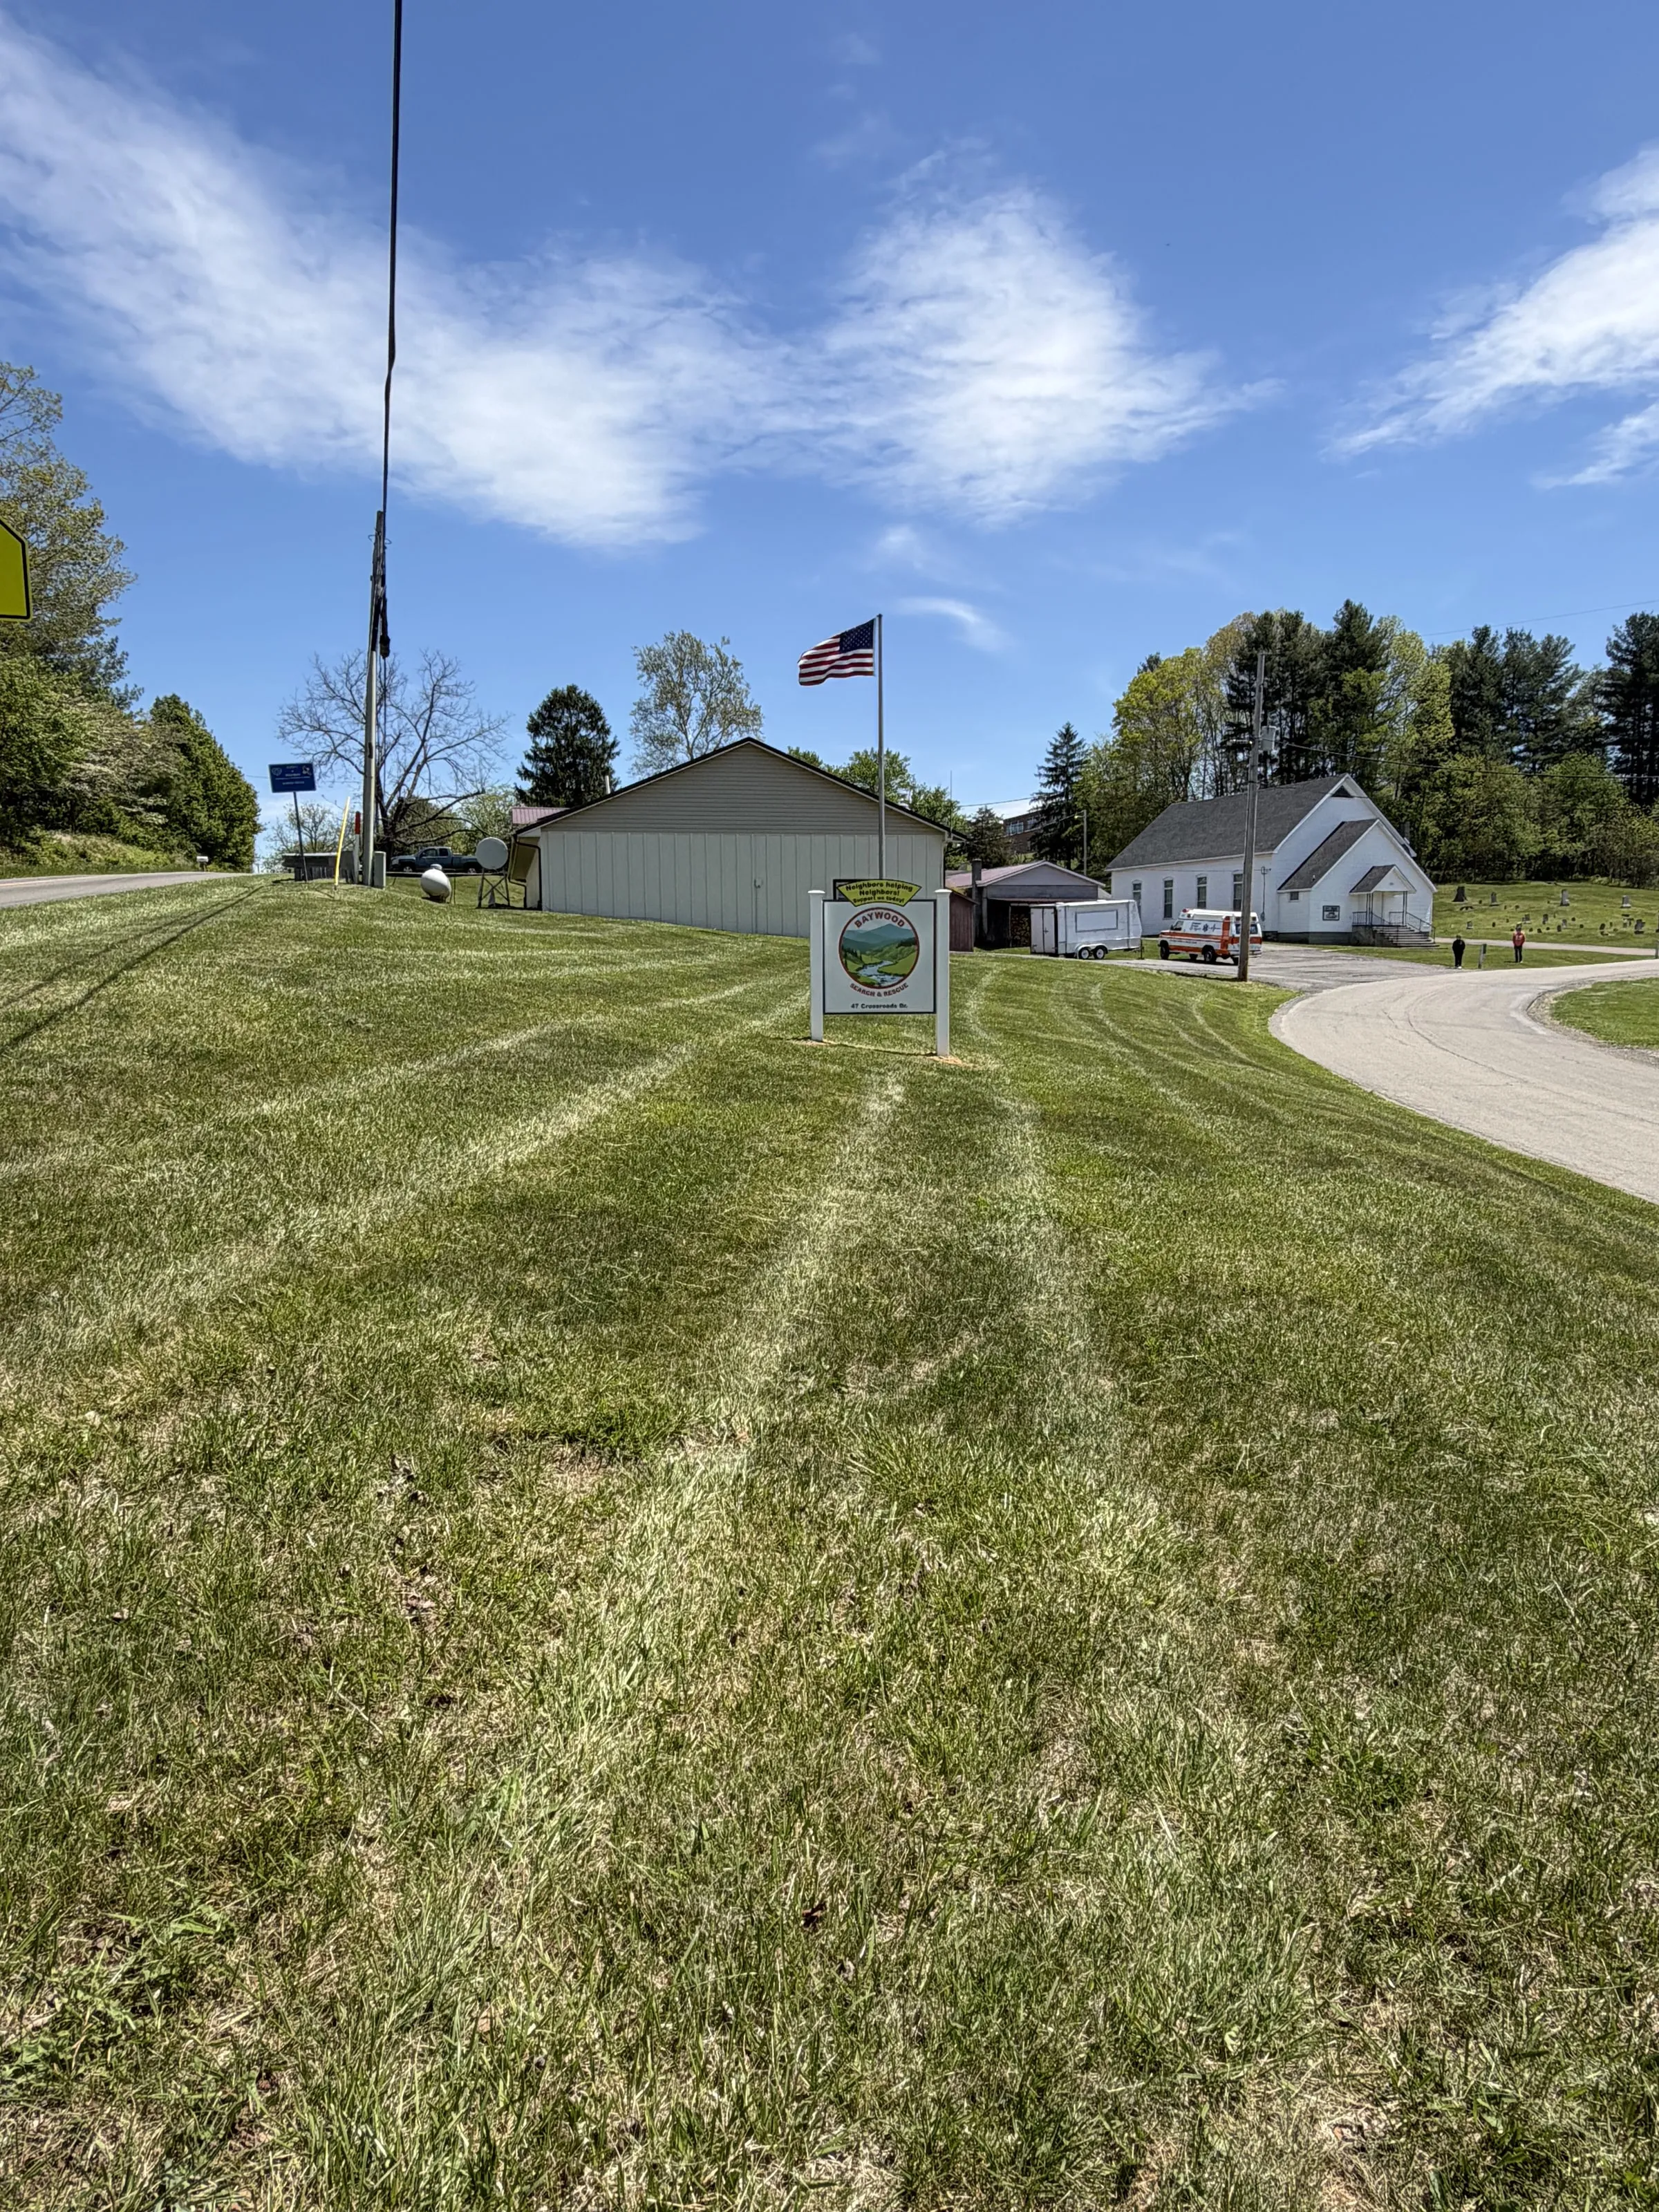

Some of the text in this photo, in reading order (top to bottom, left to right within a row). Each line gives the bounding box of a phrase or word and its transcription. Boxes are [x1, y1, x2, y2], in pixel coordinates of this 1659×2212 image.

[845, 882, 913, 892] Neighbors helping
[854, 912, 905, 928] BAYWOOD
[850, 983, 875, 997] SEARCH
[883, 982, 909, 996] RESCUE
